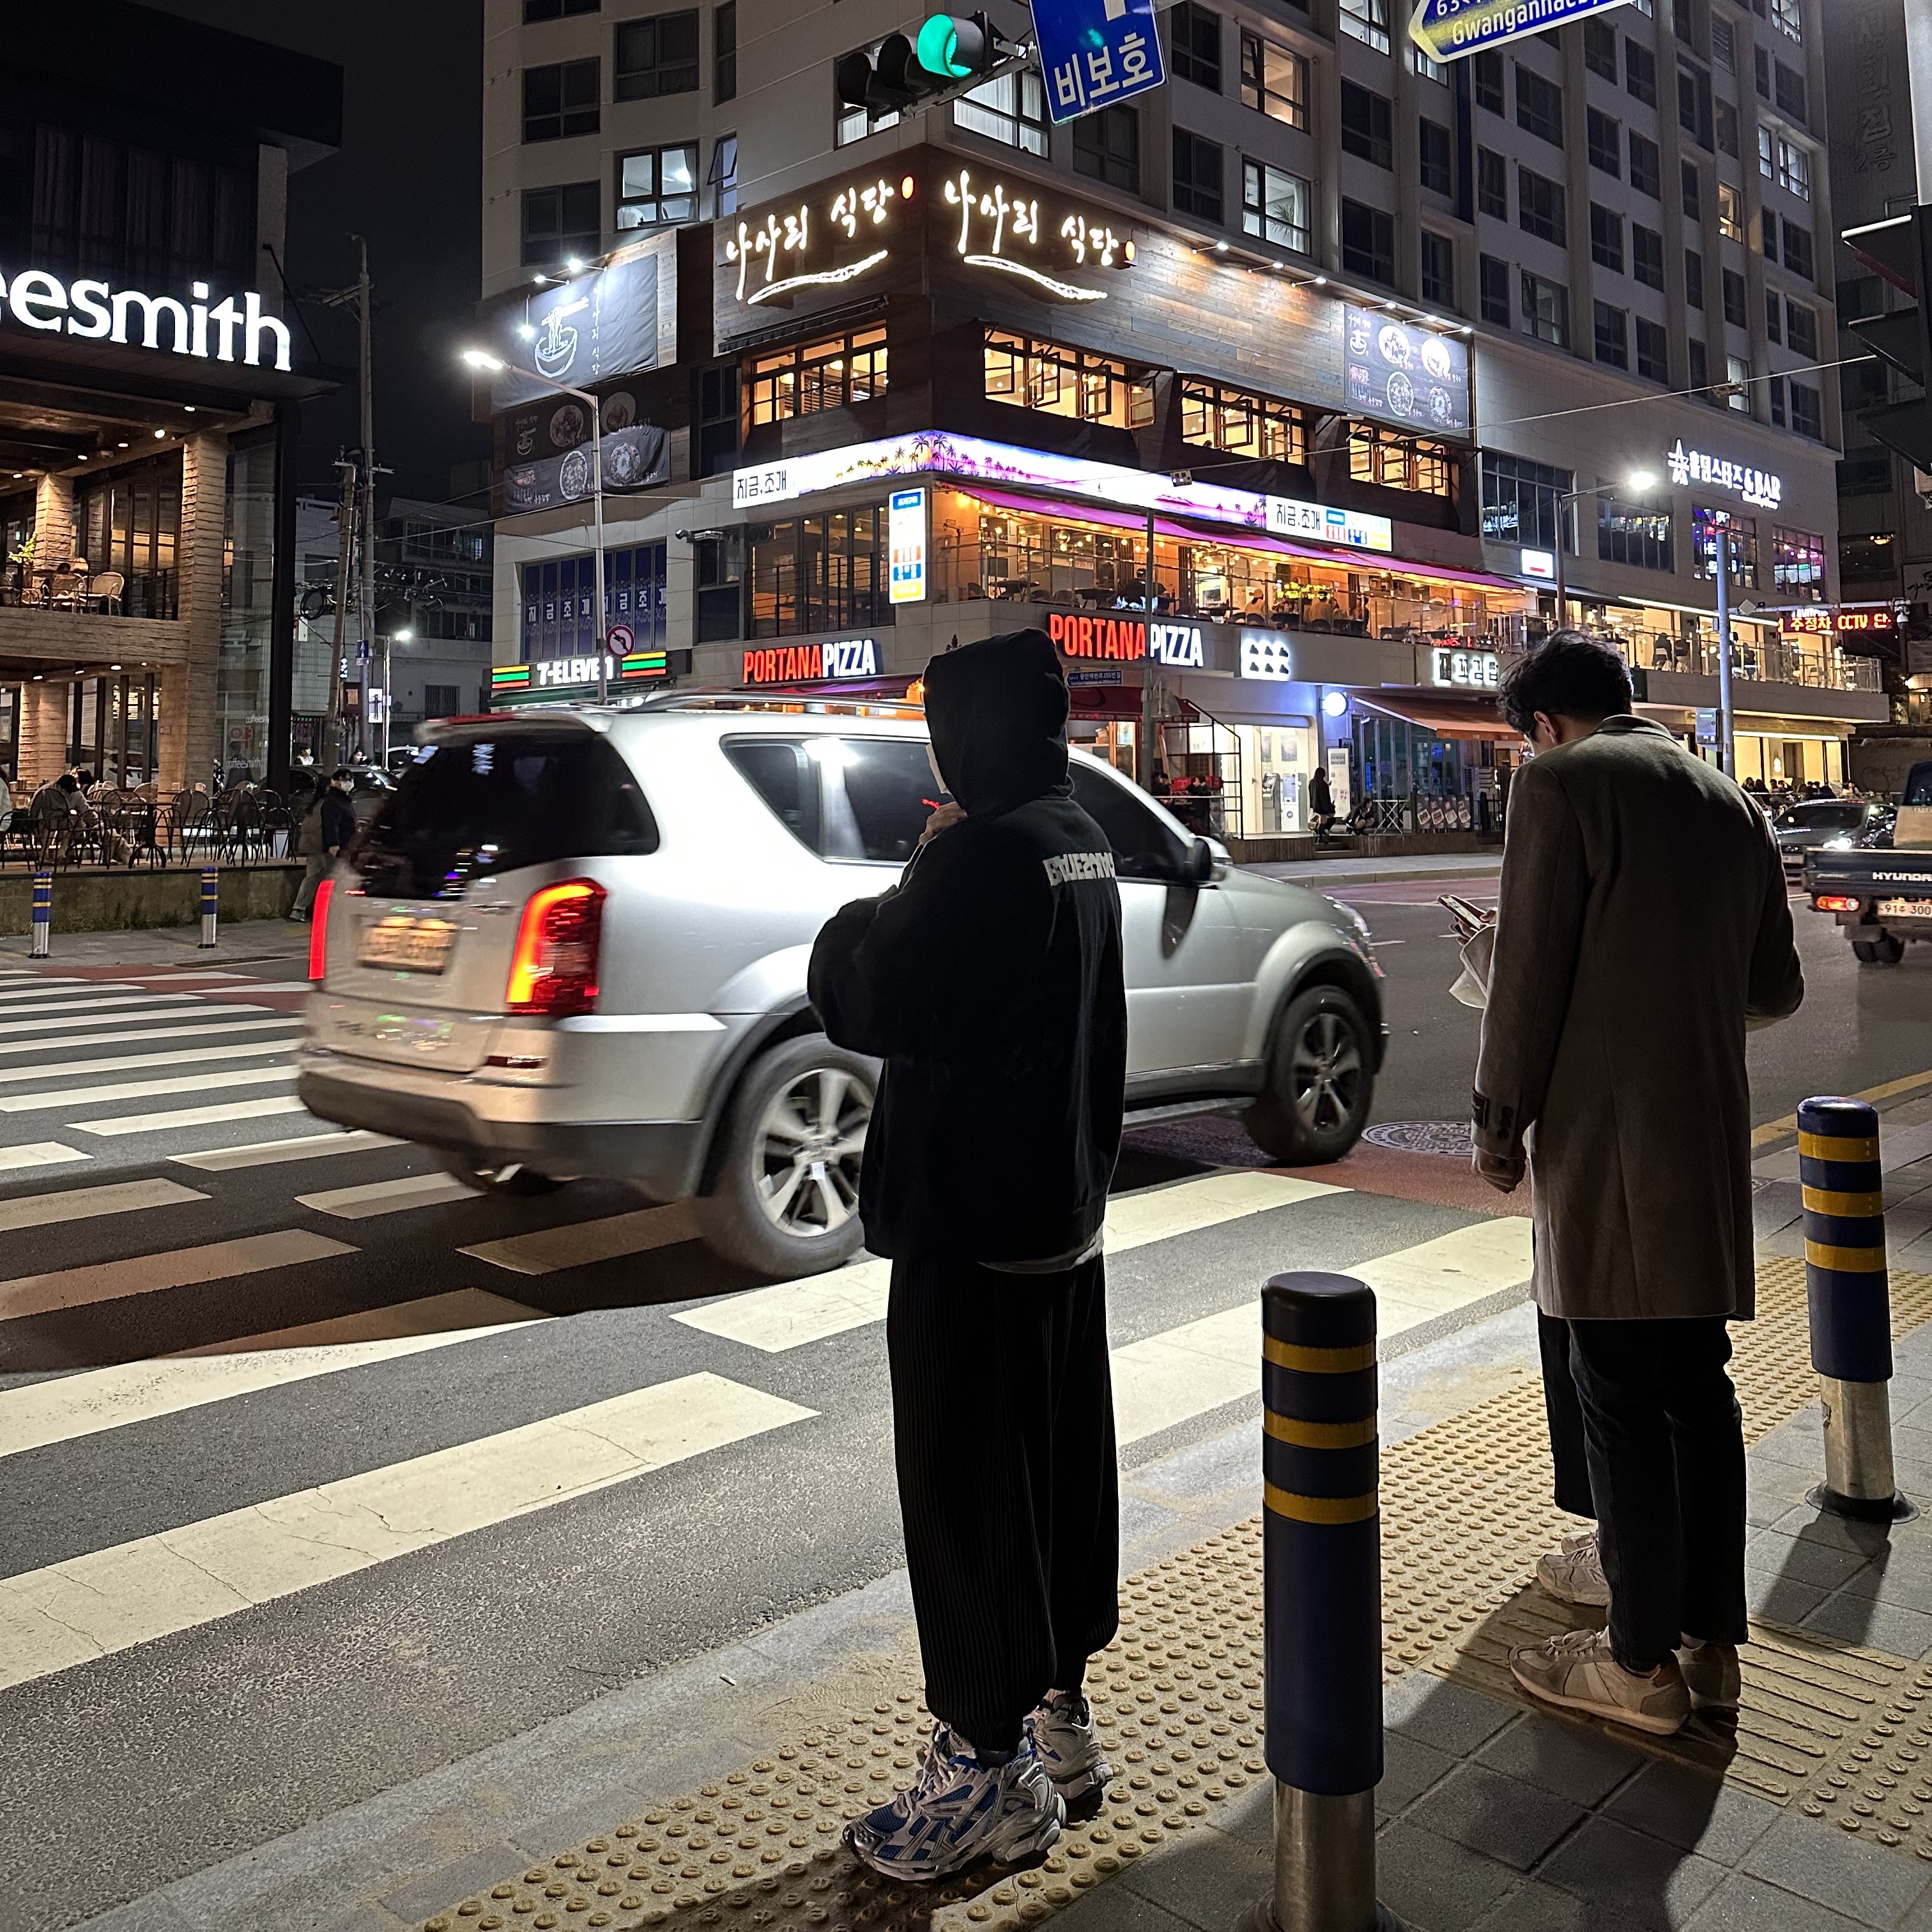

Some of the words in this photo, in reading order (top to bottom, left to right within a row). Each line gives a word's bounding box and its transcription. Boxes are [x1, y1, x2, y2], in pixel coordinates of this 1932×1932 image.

[1054, 32, 1154, 107] 비보호
[726, 204, 809, 300] 나사리
[831, 178, 894, 238] 식당
[944, 169, 1038, 254] 나사리
[1060, 215, 1119, 266] 식당
[0, 269, 291, 372] esmith
[1790, 616, 1832, 631] 주정차
[1837, 614, 1868, 630] CCTV
